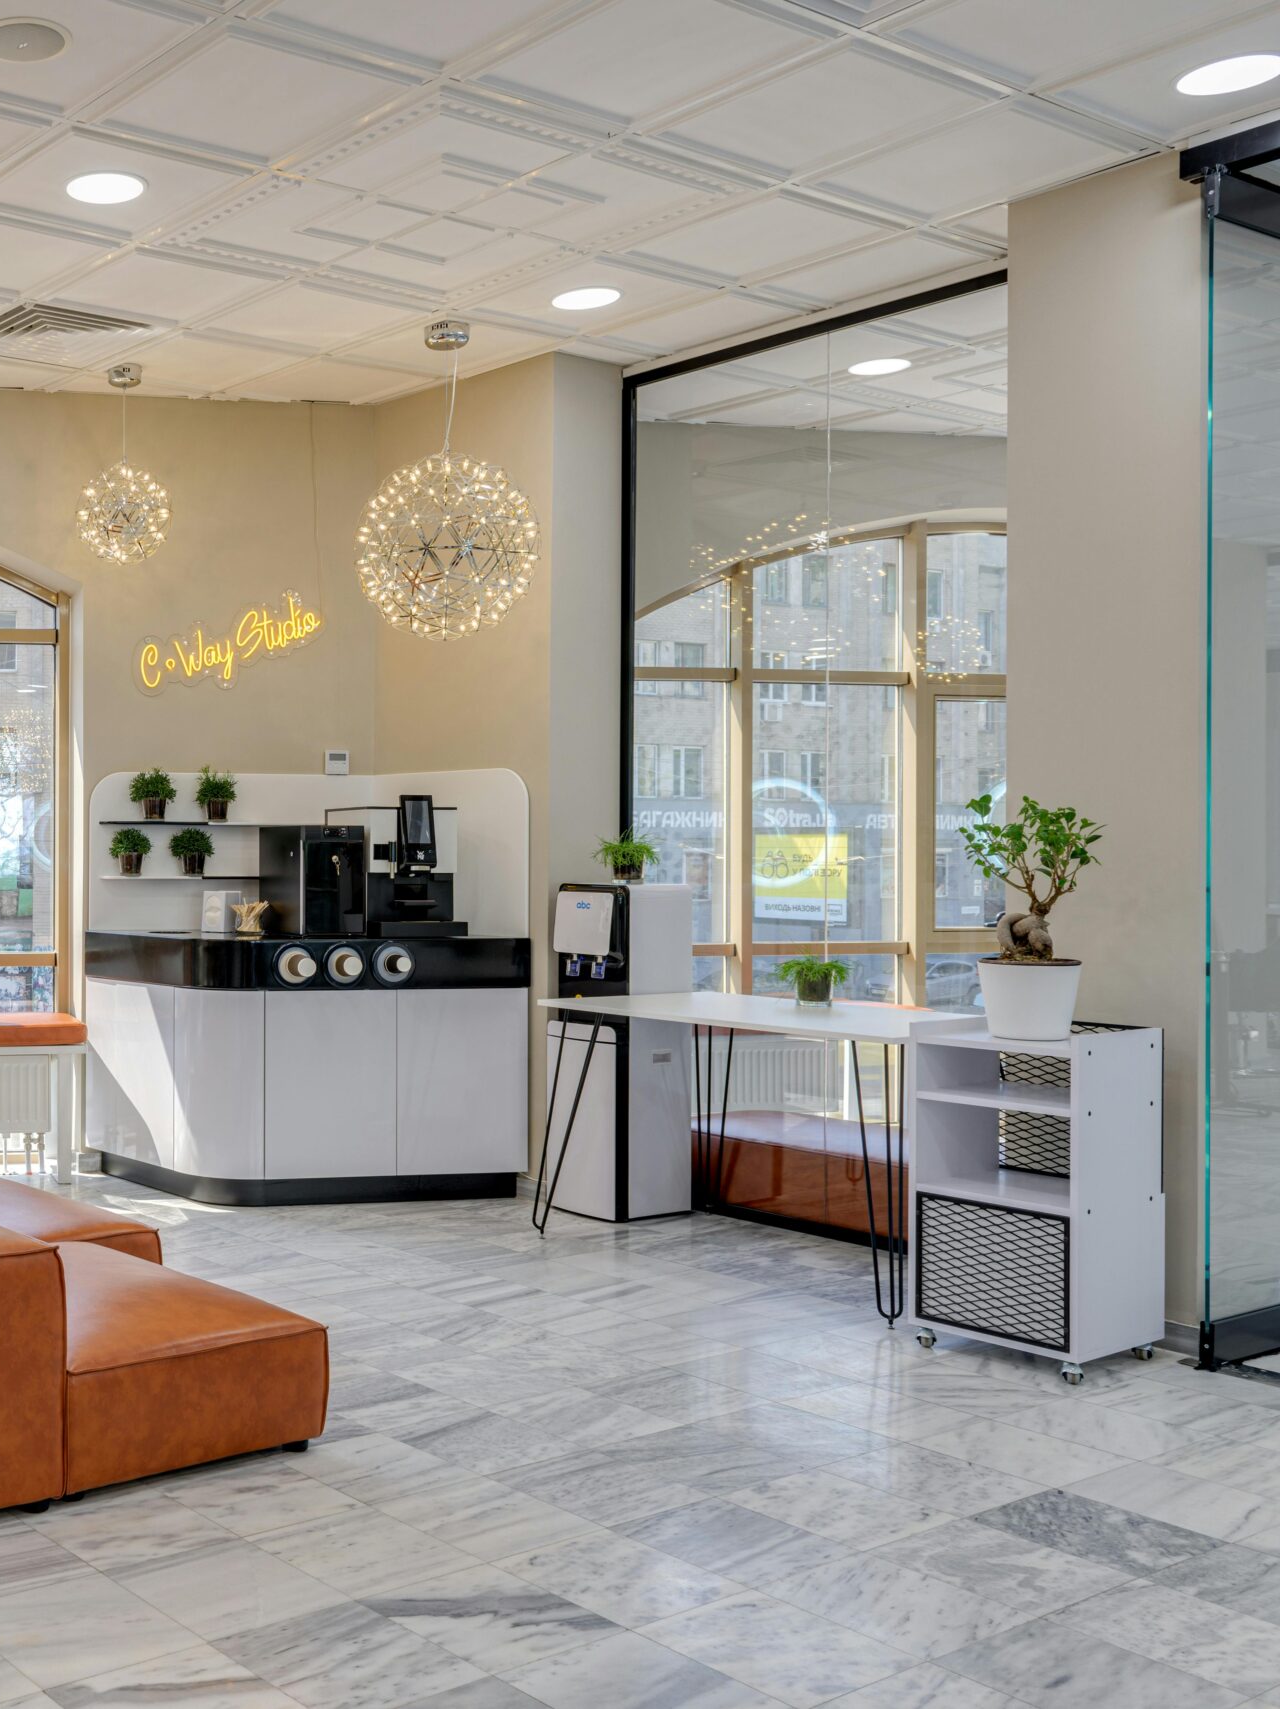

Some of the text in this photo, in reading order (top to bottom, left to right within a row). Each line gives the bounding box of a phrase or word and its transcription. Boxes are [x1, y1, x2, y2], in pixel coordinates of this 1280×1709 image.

[236, 596, 321, 659] Studio
[633, 810, 724, 829] АГАЖНИ
[576, 899, 591, 910] abc
